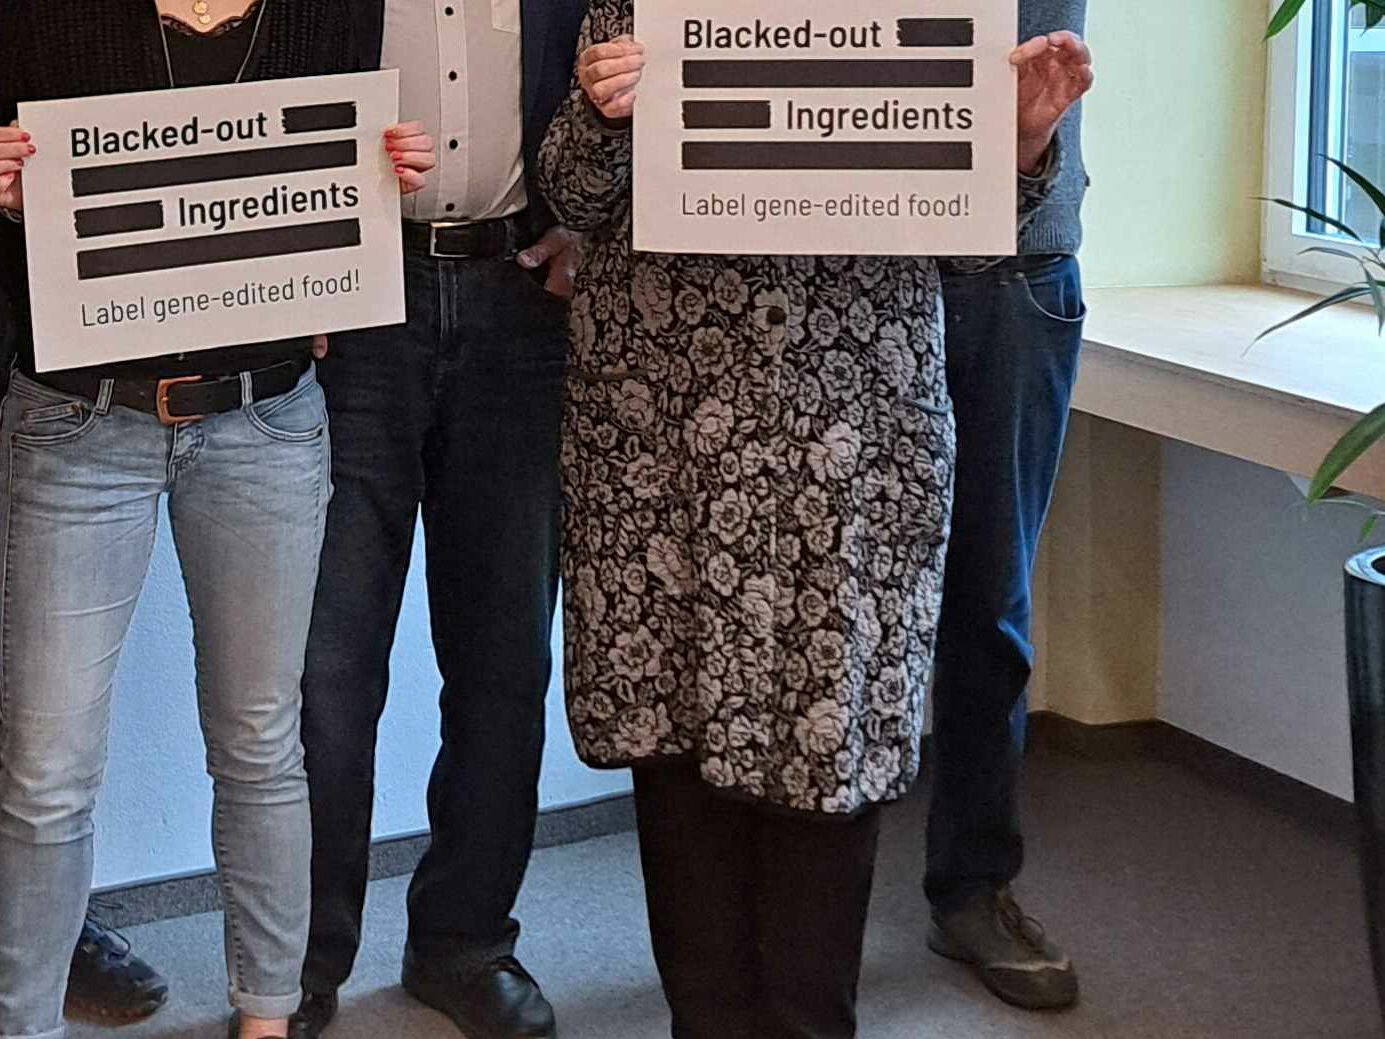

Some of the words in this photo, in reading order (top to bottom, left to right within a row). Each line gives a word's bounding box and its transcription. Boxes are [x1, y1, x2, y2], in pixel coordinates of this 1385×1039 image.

[683, 19, 883, 49] Blacked-out
[71, 112, 268, 158] Blacked-out
[787, 100, 974, 138] Ingredients
[179, 183, 359, 231] Ingredients
[682, 193, 746, 217] Label
[754, 193, 900, 222] gene-edited
[909, 194, 971, 217] food!
[81, 296, 146, 327] Label
[153, 278, 295, 323] gene-edited
[303, 268, 361, 297] food!
